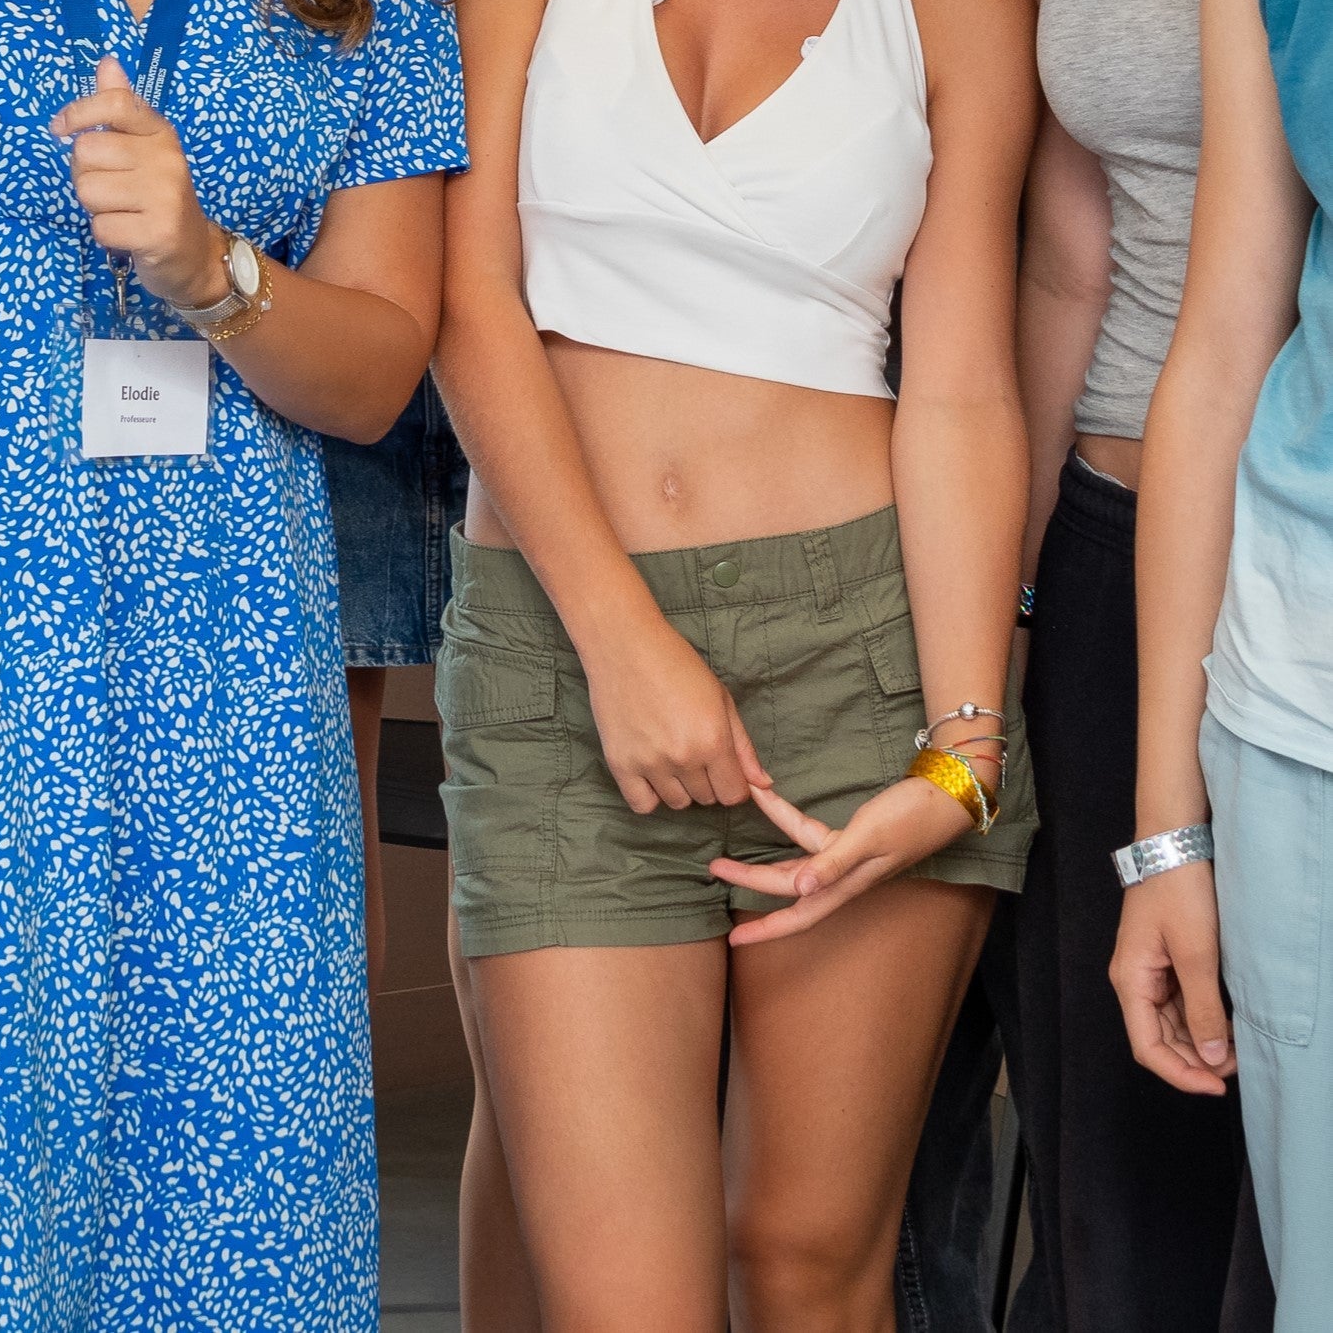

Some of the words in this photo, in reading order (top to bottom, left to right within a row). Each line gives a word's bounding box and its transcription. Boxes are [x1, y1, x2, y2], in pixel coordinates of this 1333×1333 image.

[135, 74, 146, 97] NTRE
[143, 46, 163, 102] NTERNATIONAL
[151, 67, 167, 107] D'ANTIBES
[121, 385, 161, 401] Elodie
[120, 414, 157, 424] Professeure
